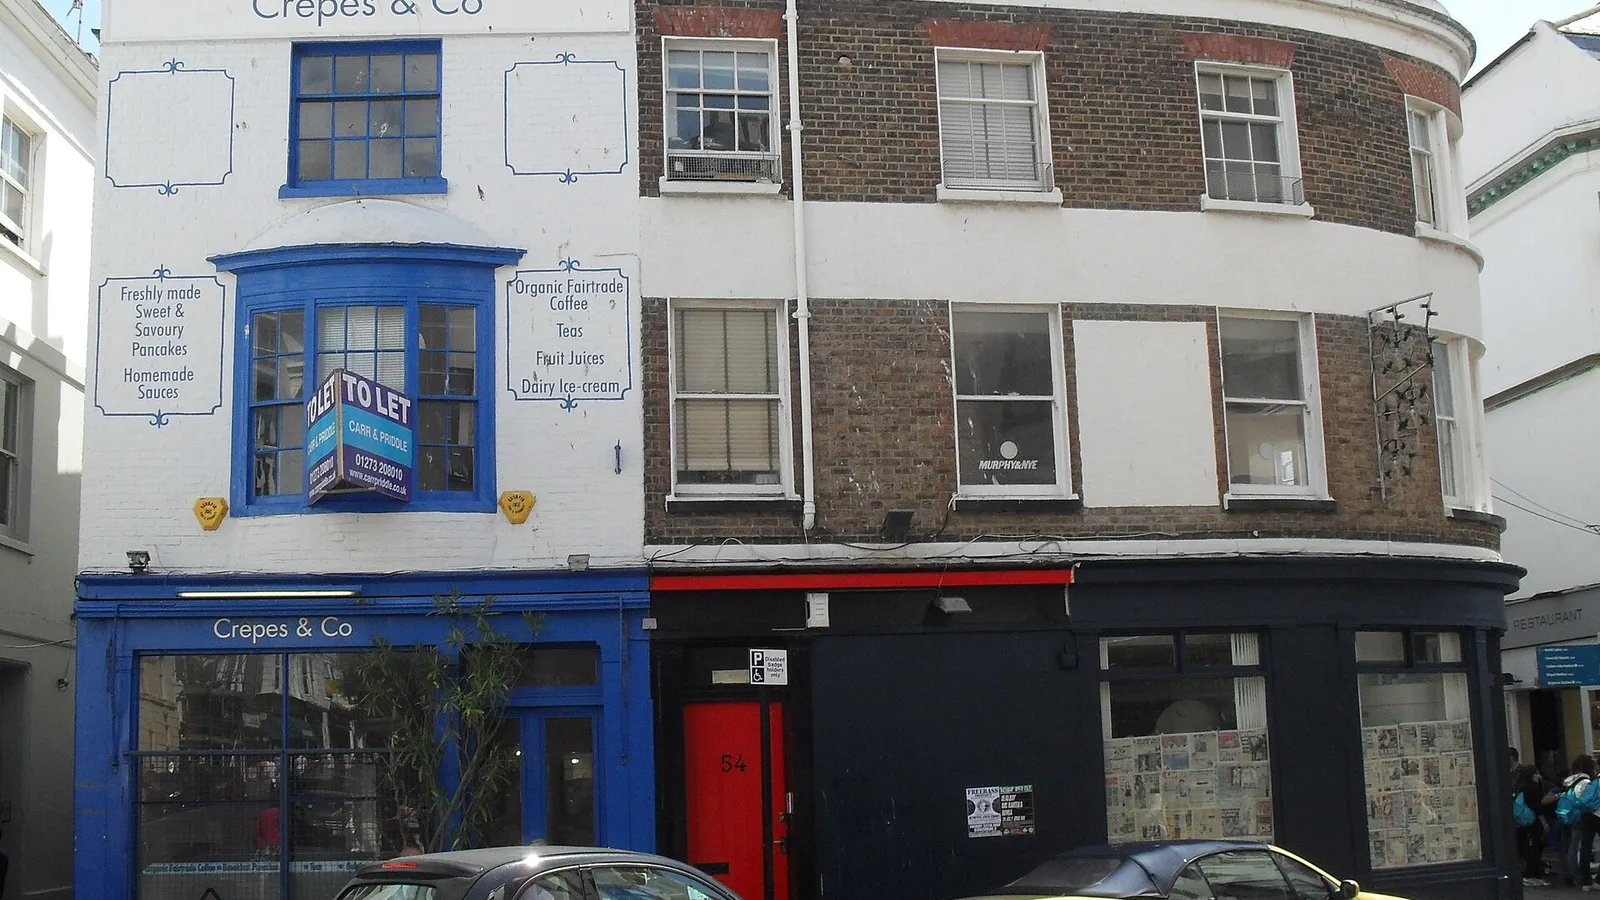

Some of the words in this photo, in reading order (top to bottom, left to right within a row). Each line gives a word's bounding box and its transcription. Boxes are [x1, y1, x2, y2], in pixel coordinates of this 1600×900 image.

[120, 285, 163, 303] Freshly
[167, 284, 201, 300] made
[515, 279, 563, 297] Organic
[567, 278, 624, 294] Fairtrade
[135, 304, 171, 319] Sweet
[175, 303, 185, 318] &
[550, 295, 588, 311] Coffee
[135, 322, 184, 339] Savoury
[556, 323, 583, 338] Teas
[132, 340, 188, 357] Pancakes
[536, 351, 565, 366] Fruit
[568, 351, 605, 365] Juices
[124, 366, 194, 383] Homemade
[138, 384, 179, 399] Sauces
[522, 378, 555, 397] Dairy
[559, 378, 620, 393] Ice-cream
[307, 395, 316, 428] TO
[317, 375, 335, 416] LET
[342, 373, 372, 408] TO
[375, 386, 411, 424] LET
[348, 420, 371, 438] CARR
[372, 428, 379, 440] &
[380, 431, 408, 453] PRIDDLE
[355, 453, 378, 472] 01273
[378, 461, 403, 481] 208010
[978, 460, 1038, 470] MURPHY&NYE
[296, 617, 313, 637] &
[321, 616, 353, 637] Co
[1513, 608, 1582, 630] RESTAURANT
[753, 652, 763, 666] P
[720, 754, 747, 773] 54
